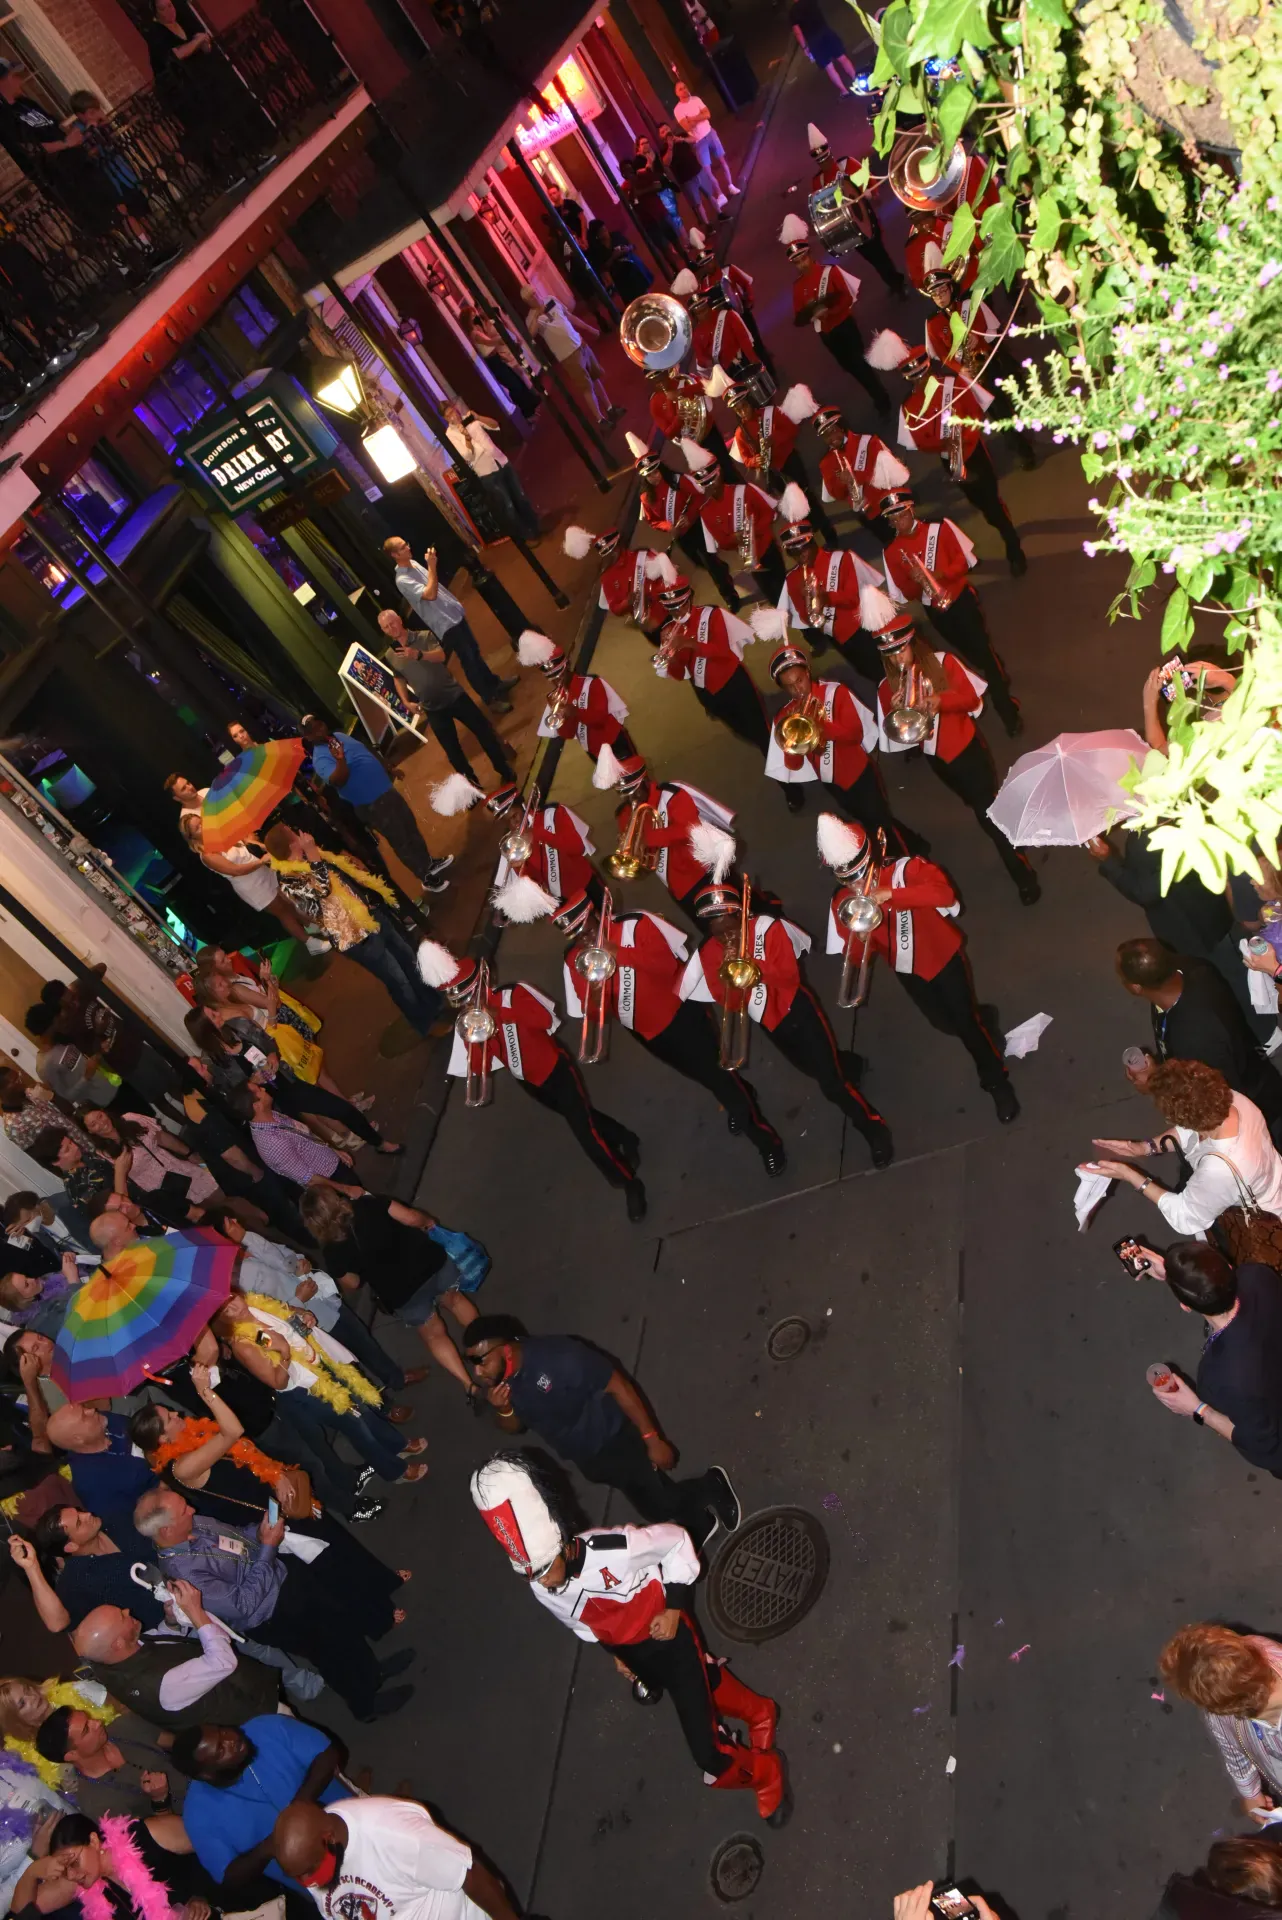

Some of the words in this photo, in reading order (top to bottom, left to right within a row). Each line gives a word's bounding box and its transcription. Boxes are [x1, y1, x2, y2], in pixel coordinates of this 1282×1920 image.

[202, 433, 240, 468] BOURBON
[239, 417, 277, 436] SEET
[211, 427, 292, 487] DRINKRY
[233, 475, 256, 494] NEW
[927, 535, 937, 571] ODORES
[505, 1023, 519, 1069] COMMODO
[598, 1566, 623, 1592] A
[730, 1550, 805, 1601] WATER
[354, 1876, 394, 1908] ACADEMY
